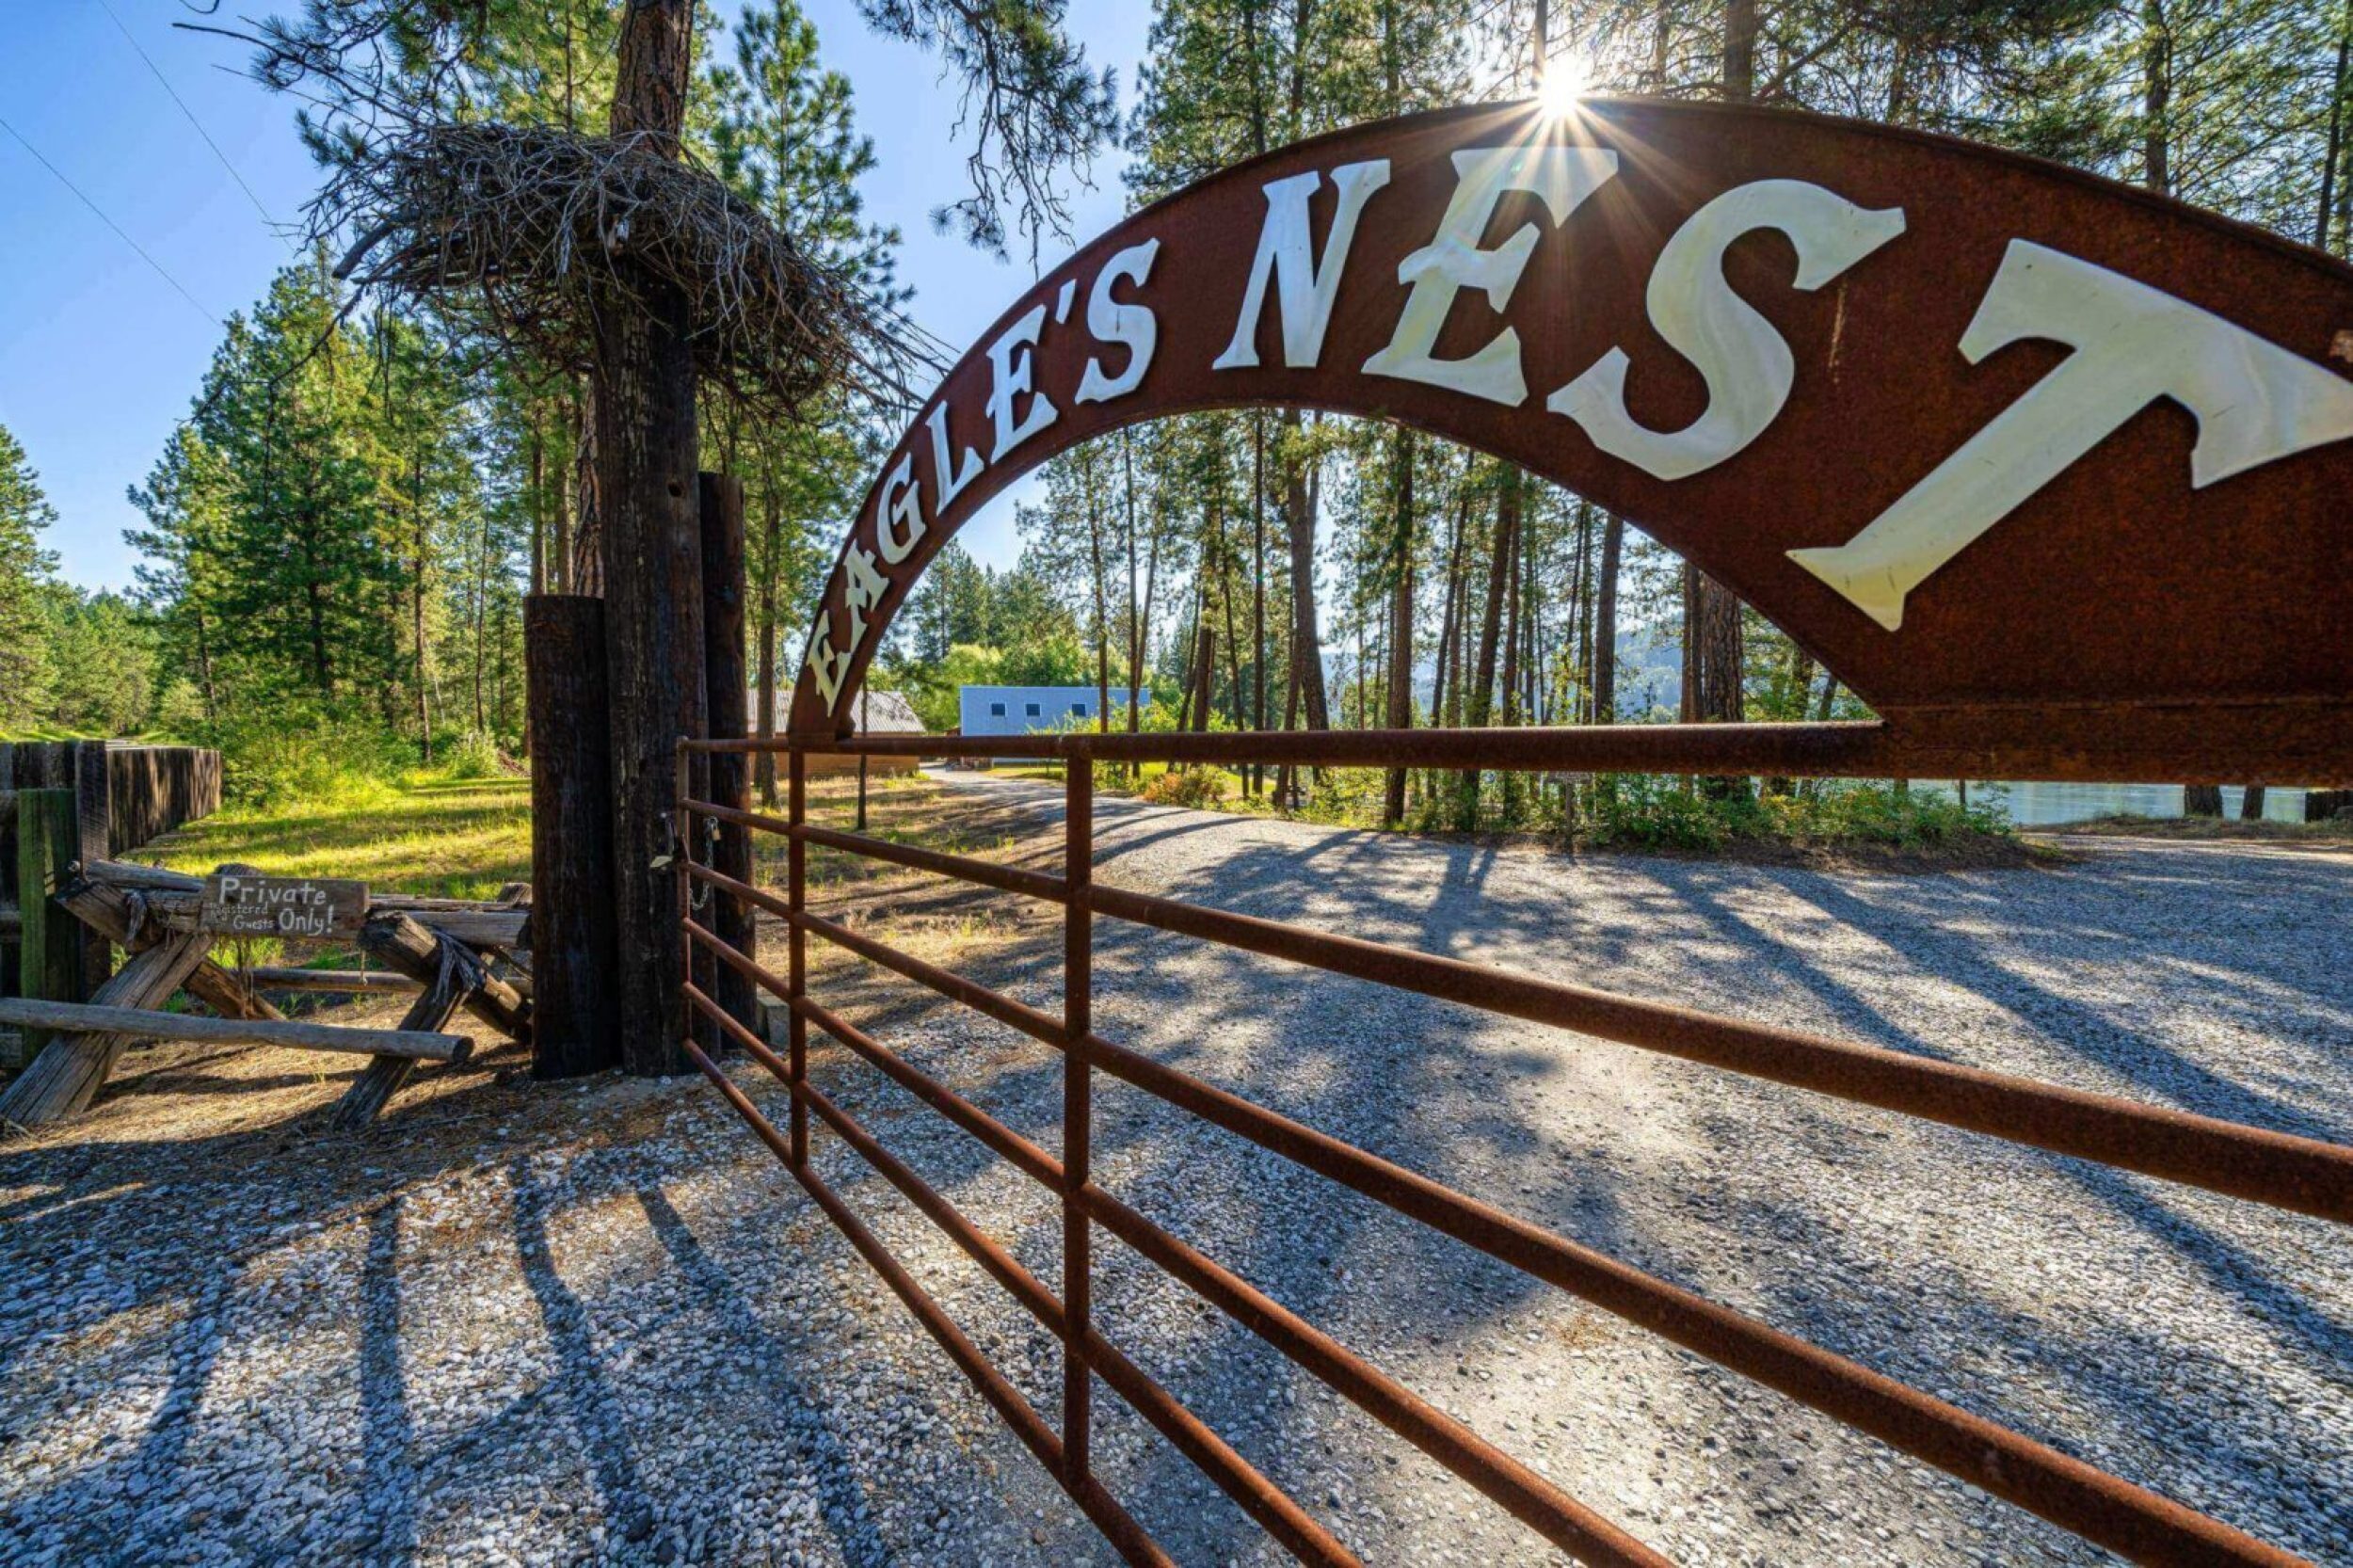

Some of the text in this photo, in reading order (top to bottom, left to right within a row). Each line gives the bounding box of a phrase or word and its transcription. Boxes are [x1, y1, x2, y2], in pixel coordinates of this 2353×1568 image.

[806, 146, 2353, 717] EAGLE'S NEST
[219, 877, 327, 904] Private
[232, 904, 334, 936] Guests Only!
